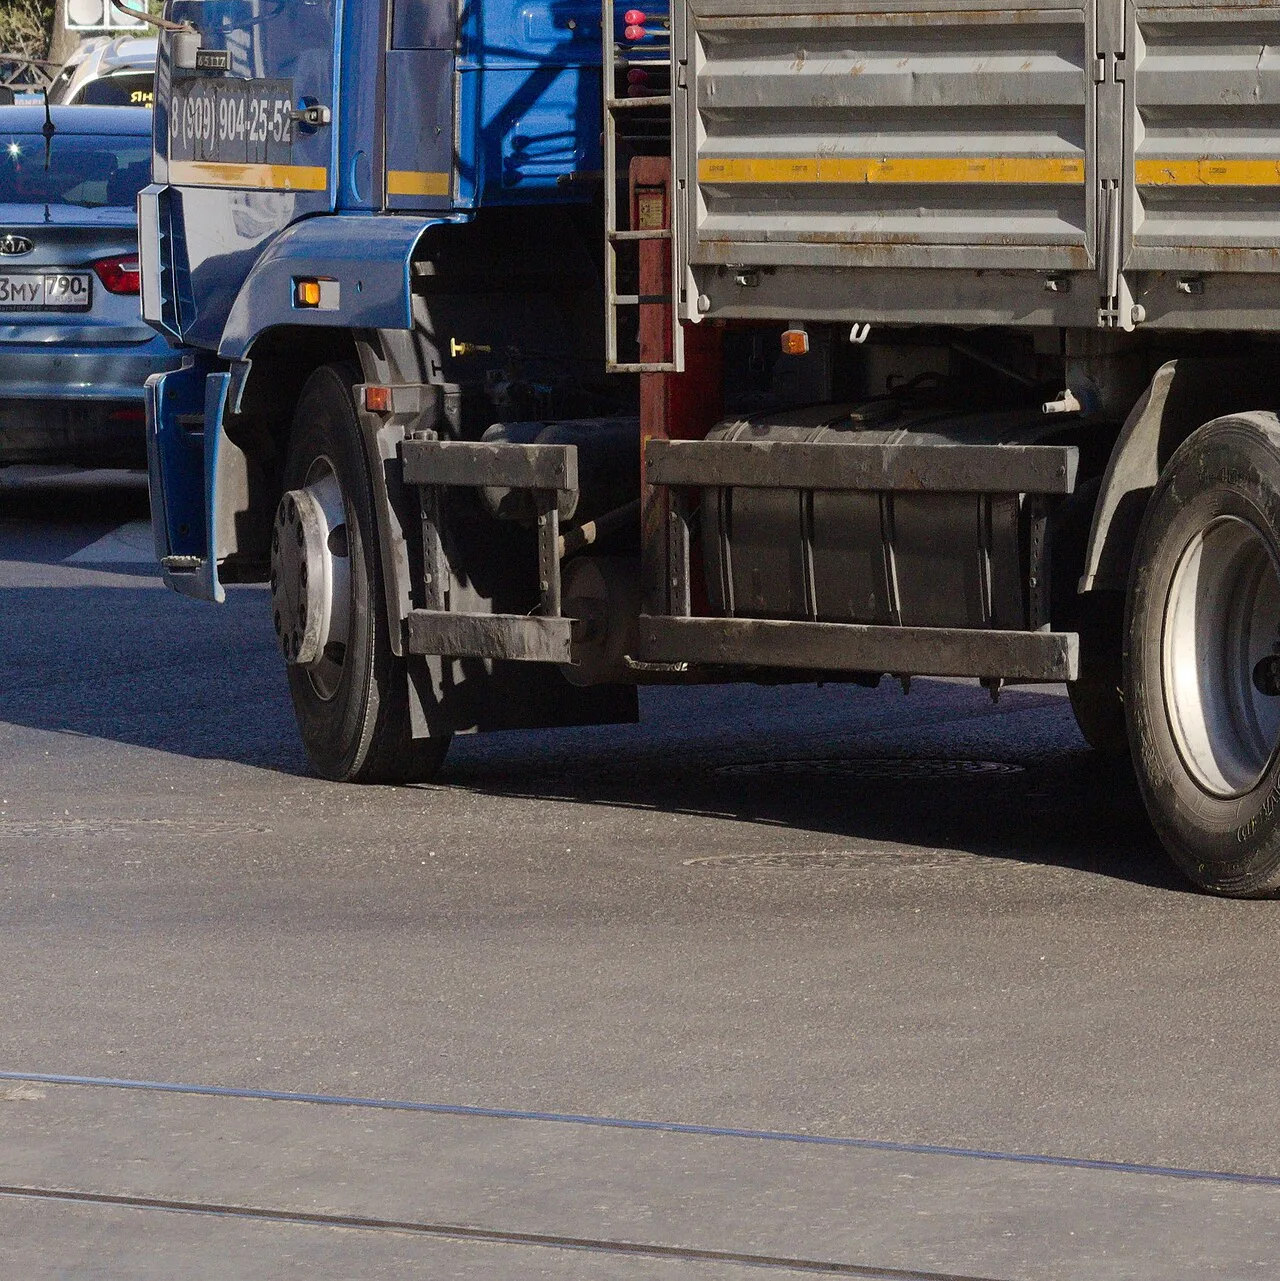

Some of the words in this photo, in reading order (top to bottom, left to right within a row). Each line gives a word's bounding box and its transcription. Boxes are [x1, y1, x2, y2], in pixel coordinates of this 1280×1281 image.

[171, 96, 179, 139] 8
[182, 94, 216, 152] (909)
[219, 98, 292, 142] 904-25-52
[46, 276, 83, 295] 790
